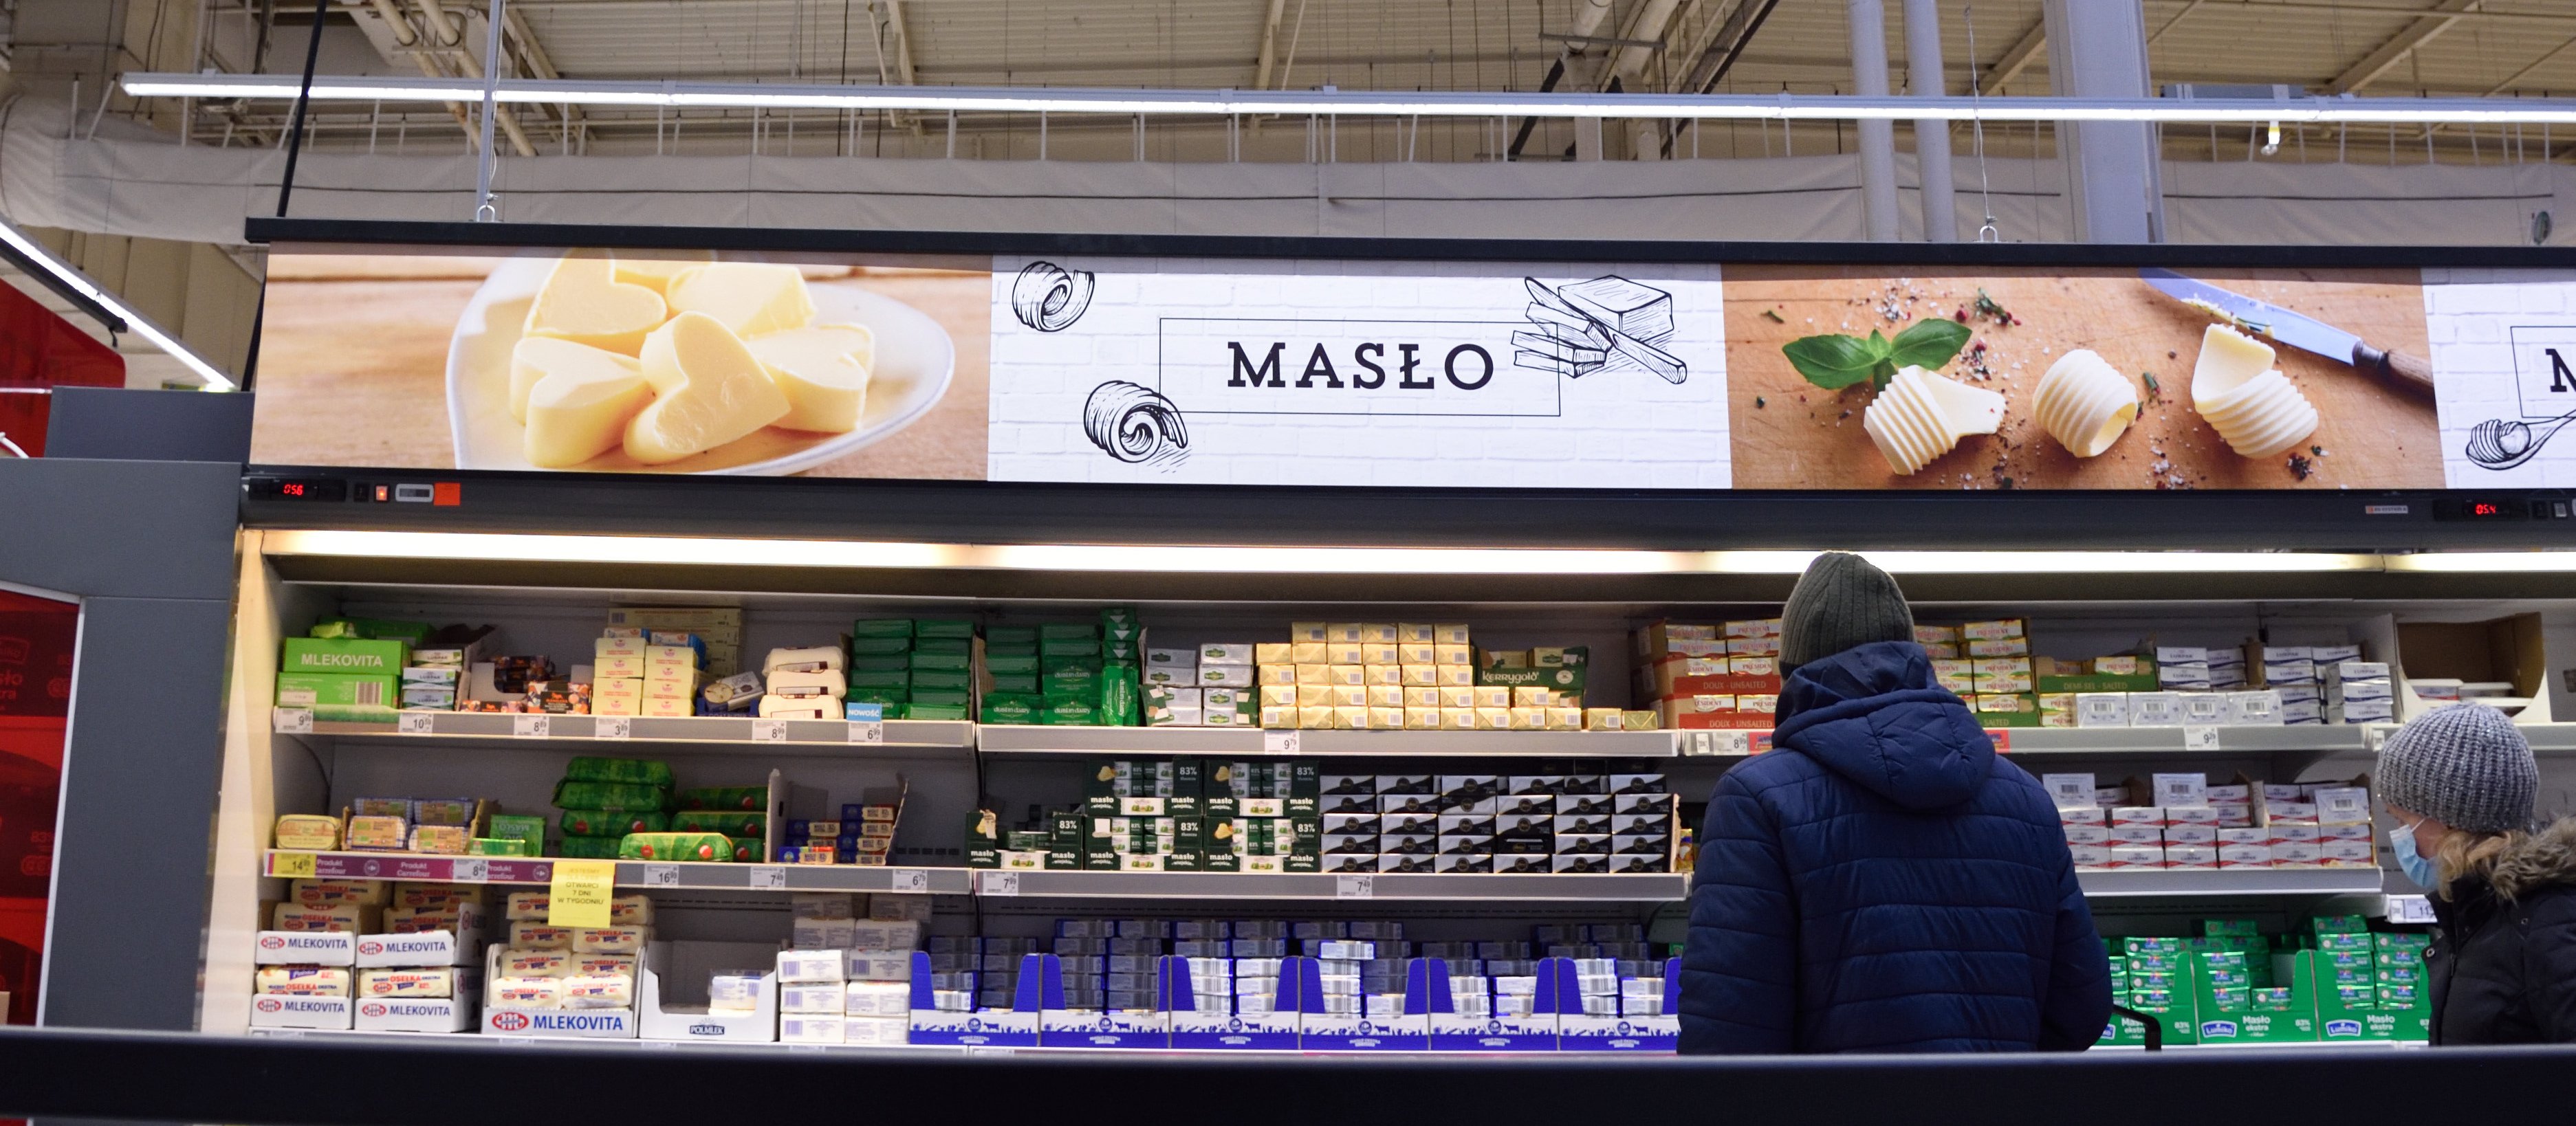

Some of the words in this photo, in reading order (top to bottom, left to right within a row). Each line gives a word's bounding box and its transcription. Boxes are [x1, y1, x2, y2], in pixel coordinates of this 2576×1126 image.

[1227, 342, 1494, 390] MASŁO
[301, 654, 382, 667] MLEKOVITA
[1180, 766, 1197, 775] 83%
[1297, 766, 1314, 775] 83%
[1059, 820, 1077, 830] 83%
[1181, 823, 1199, 832] 83%
[1298, 824, 1316, 832] 83%
[401, 862, 427, 870] Produkt
[397, 870, 430, 878] Carrefour
[488, 872, 515, 881] arrefour
[288, 938, 348, 949] MLEKOVITA
[386, 942, 446, 953] MLEKOVITA
[285, 1001, 345, 1013] MLEKOVITA
[389, 1005, 450, 1017] MLEKOVITA
[534, 1015, 623, 1030] MLEKOVITA
